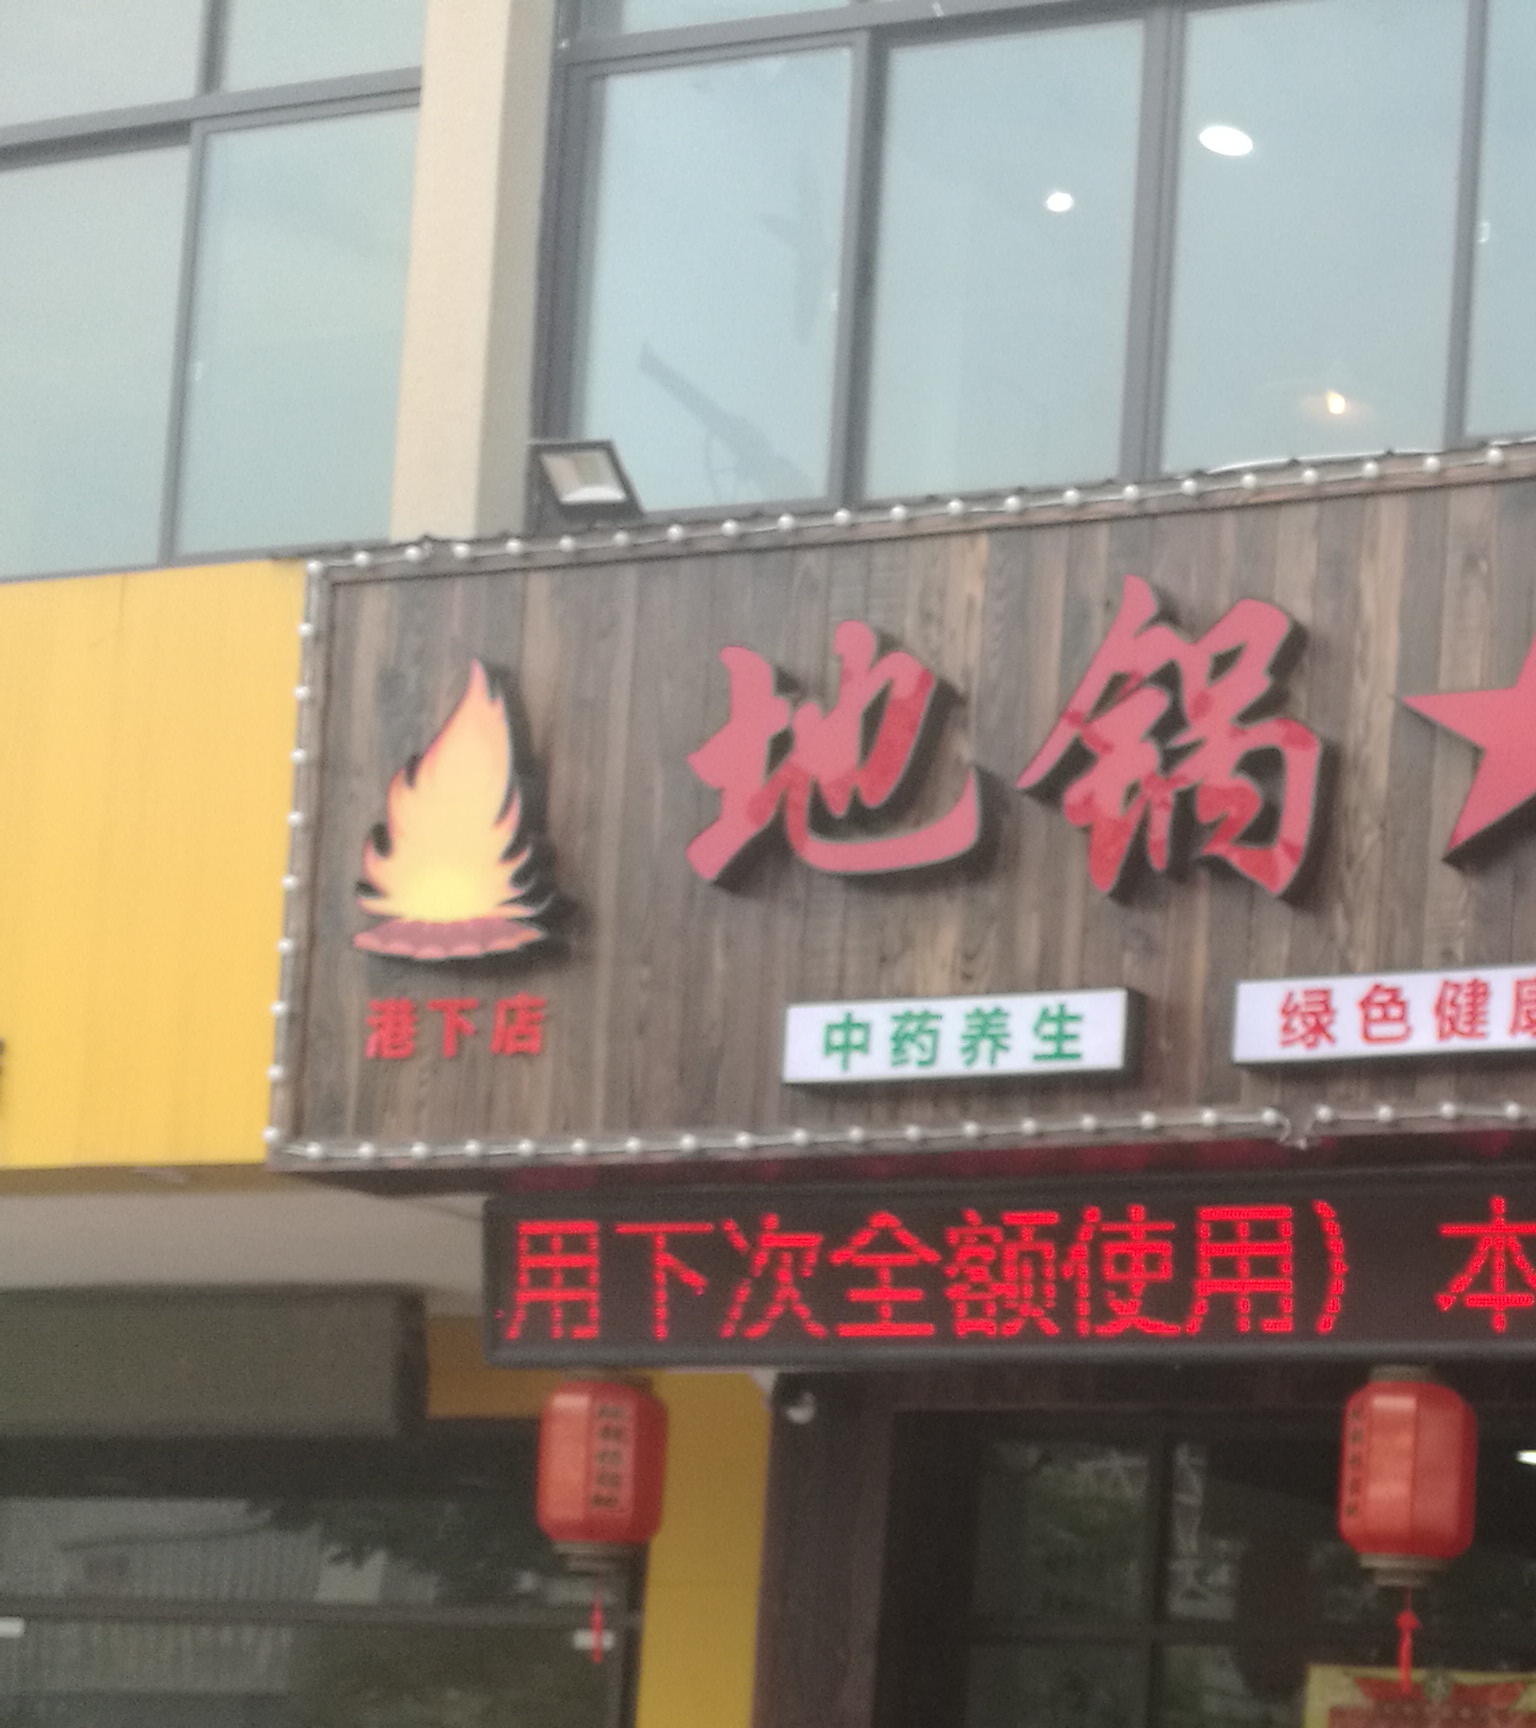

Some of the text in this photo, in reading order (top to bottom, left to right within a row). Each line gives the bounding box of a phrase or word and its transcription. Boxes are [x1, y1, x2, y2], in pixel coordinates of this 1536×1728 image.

[365, 997, 549, 1061] 港下店
[821, 1000, 1087, 1072] 中药养生
